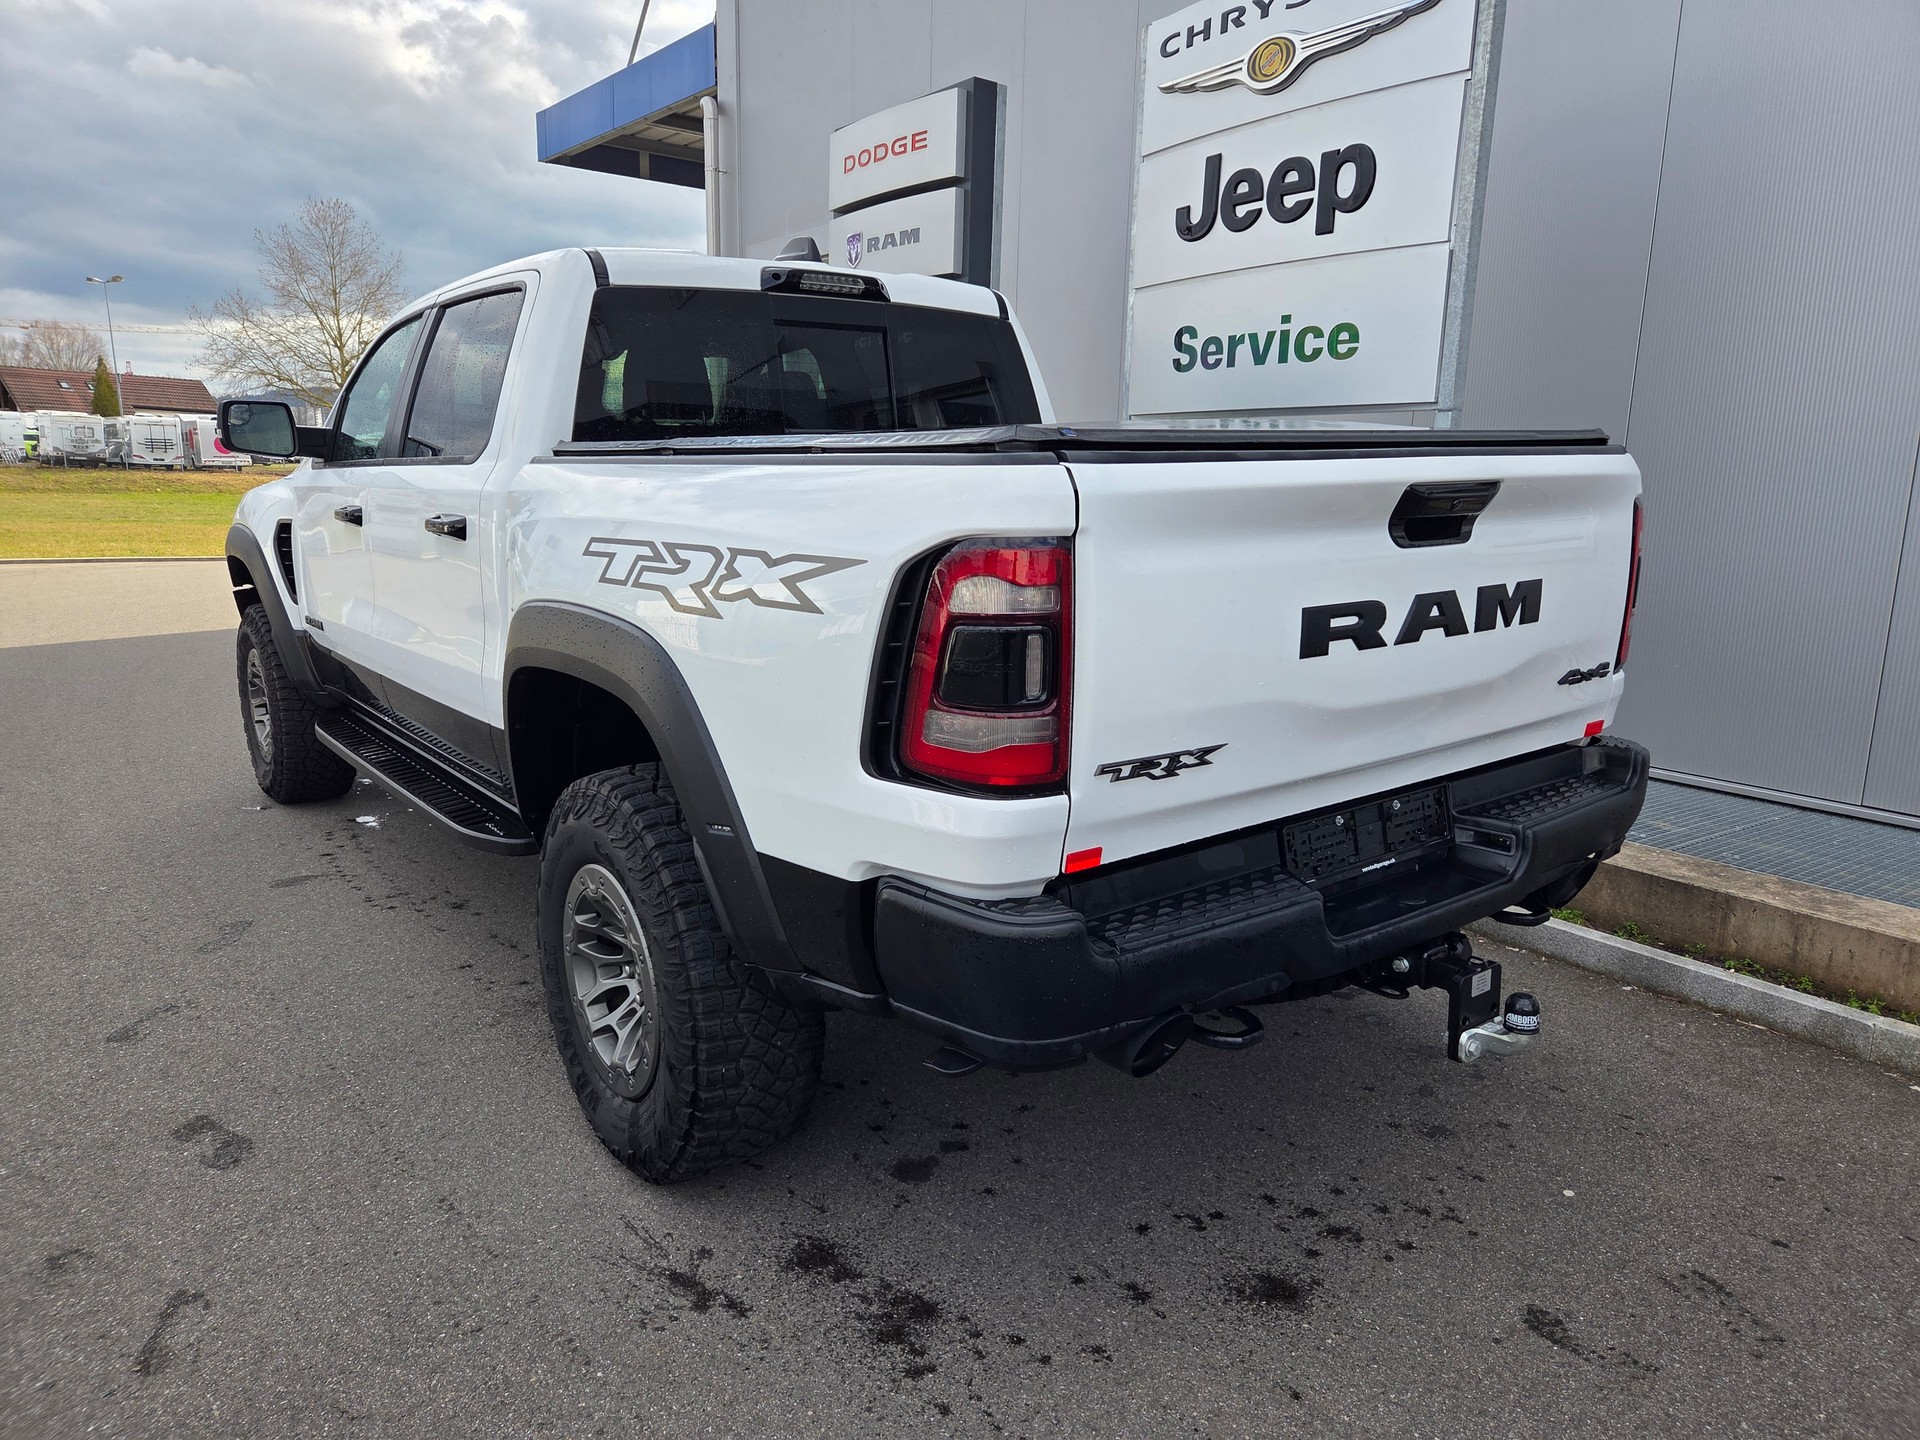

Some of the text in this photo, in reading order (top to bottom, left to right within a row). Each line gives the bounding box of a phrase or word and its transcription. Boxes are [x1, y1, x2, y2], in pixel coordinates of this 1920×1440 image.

[843, 130, 928, 174] DODGE
[1175, 142, 1377, 243] Jeep
[867, 227, 920, 254] RAM
[1172, 314, 1360, 373] Service
[582, 536, 868, 618] TRX
[1300, 578, 1543, 659] RAM
[1094, 743, 1229, 783] TRX
